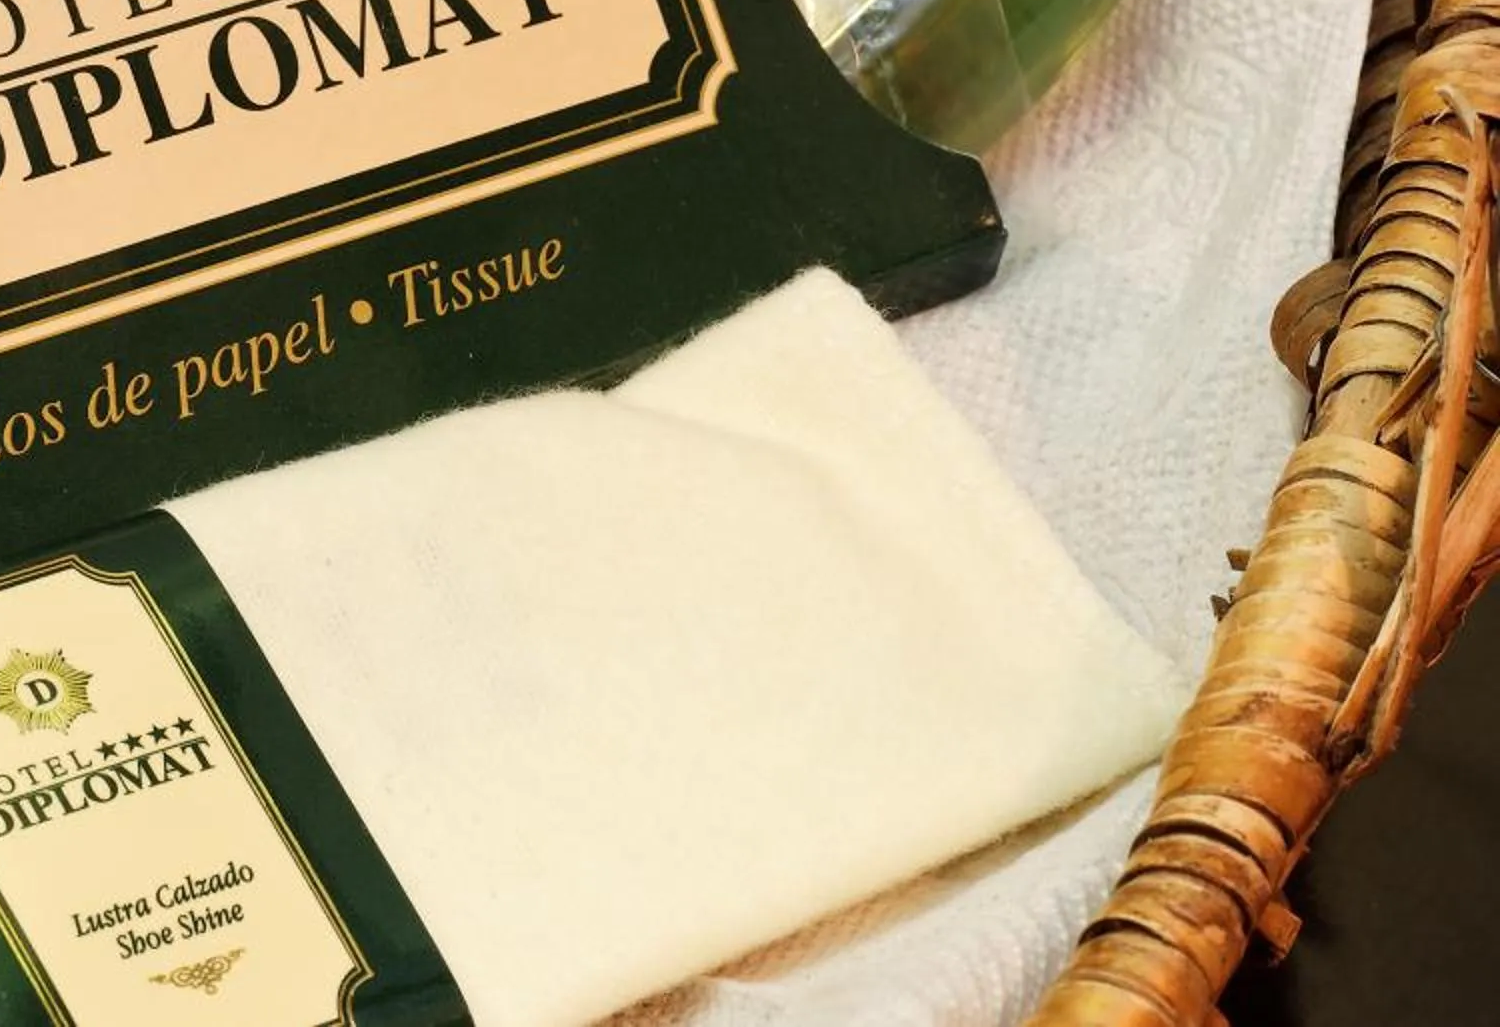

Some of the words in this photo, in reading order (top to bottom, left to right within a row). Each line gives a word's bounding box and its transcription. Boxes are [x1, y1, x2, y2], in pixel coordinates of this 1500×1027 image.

[88, 363, 154, 428] de
[171, 293, 335, 420] papel
[388, 237, 566, 330] Tissue
[24, 677, 59, 708] D
[71, 897, 151, 938] Lustra
[155, 861, 255, 909] Calzado
[116, 926, 174, 960] Shoe
[177, 903, 245, 939] Shine
